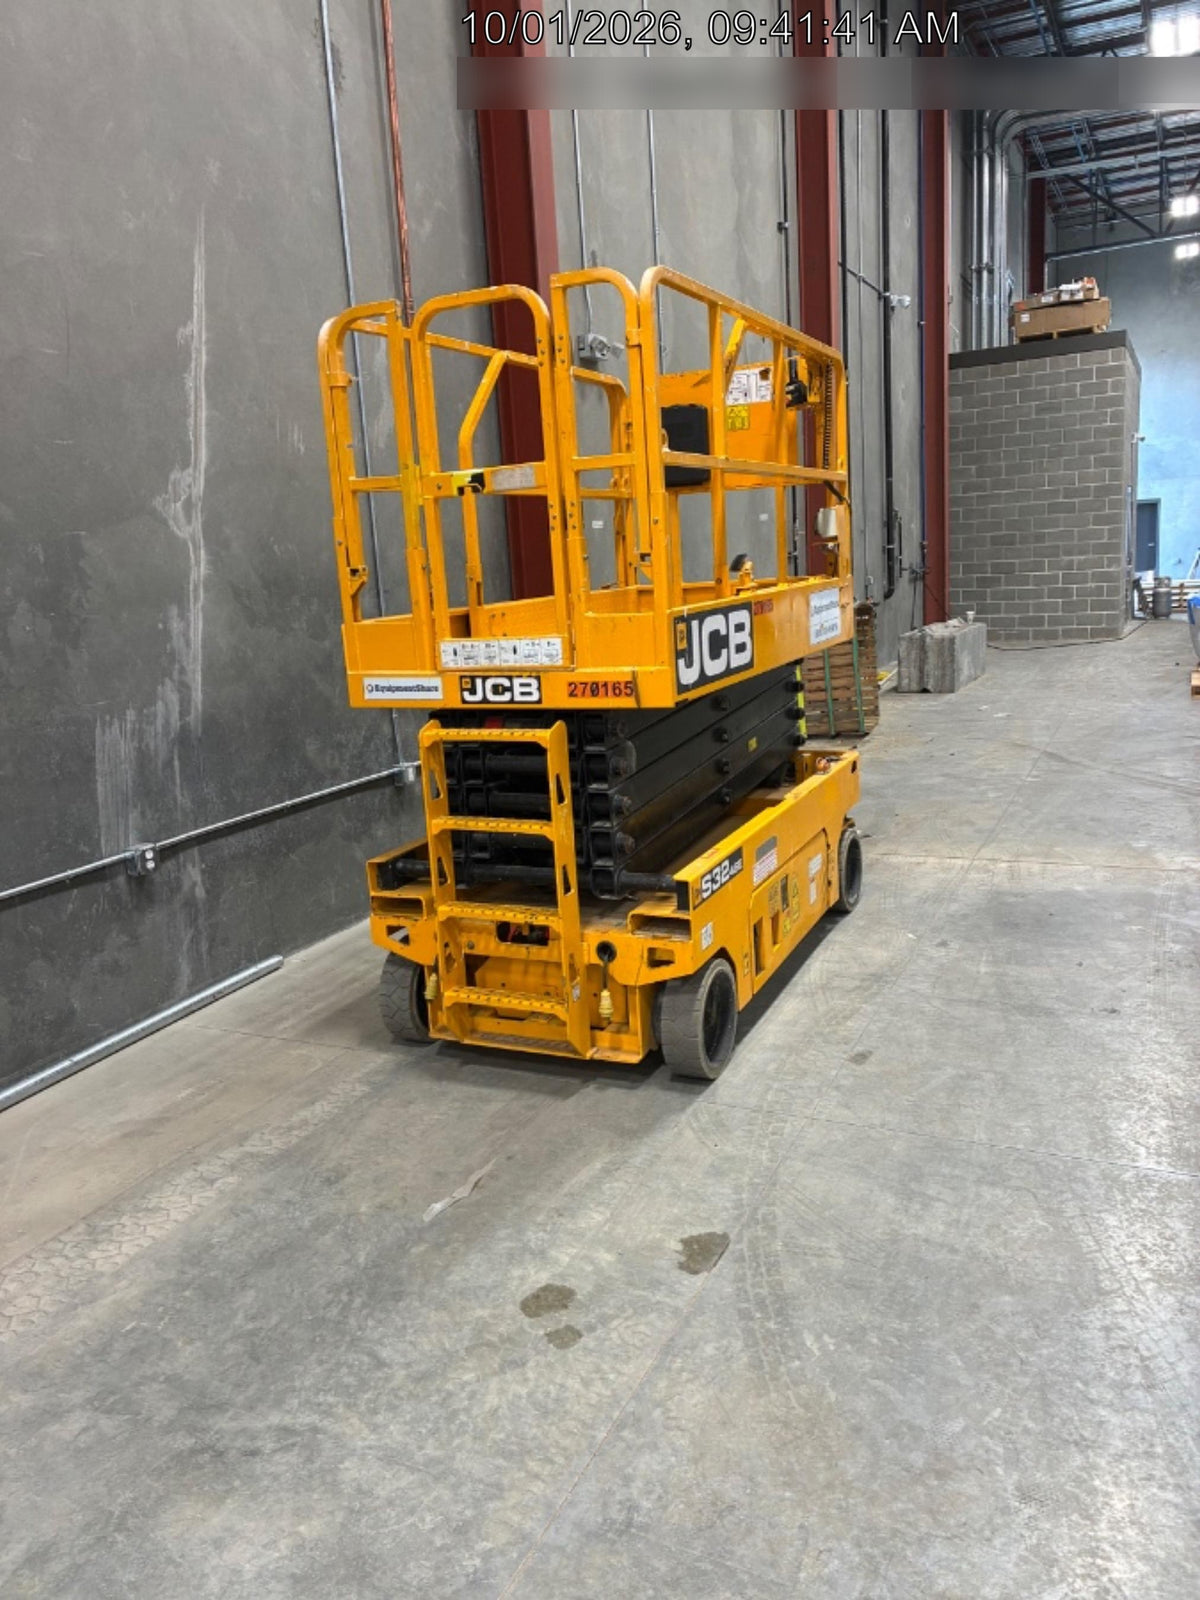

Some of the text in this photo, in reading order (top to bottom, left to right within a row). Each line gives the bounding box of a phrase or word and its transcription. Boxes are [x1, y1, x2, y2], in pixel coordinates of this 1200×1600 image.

[677, 609, 753, 686] JCB
[462, 676, 540, 703] JCB
[568, 680, 634, 698] 270165
